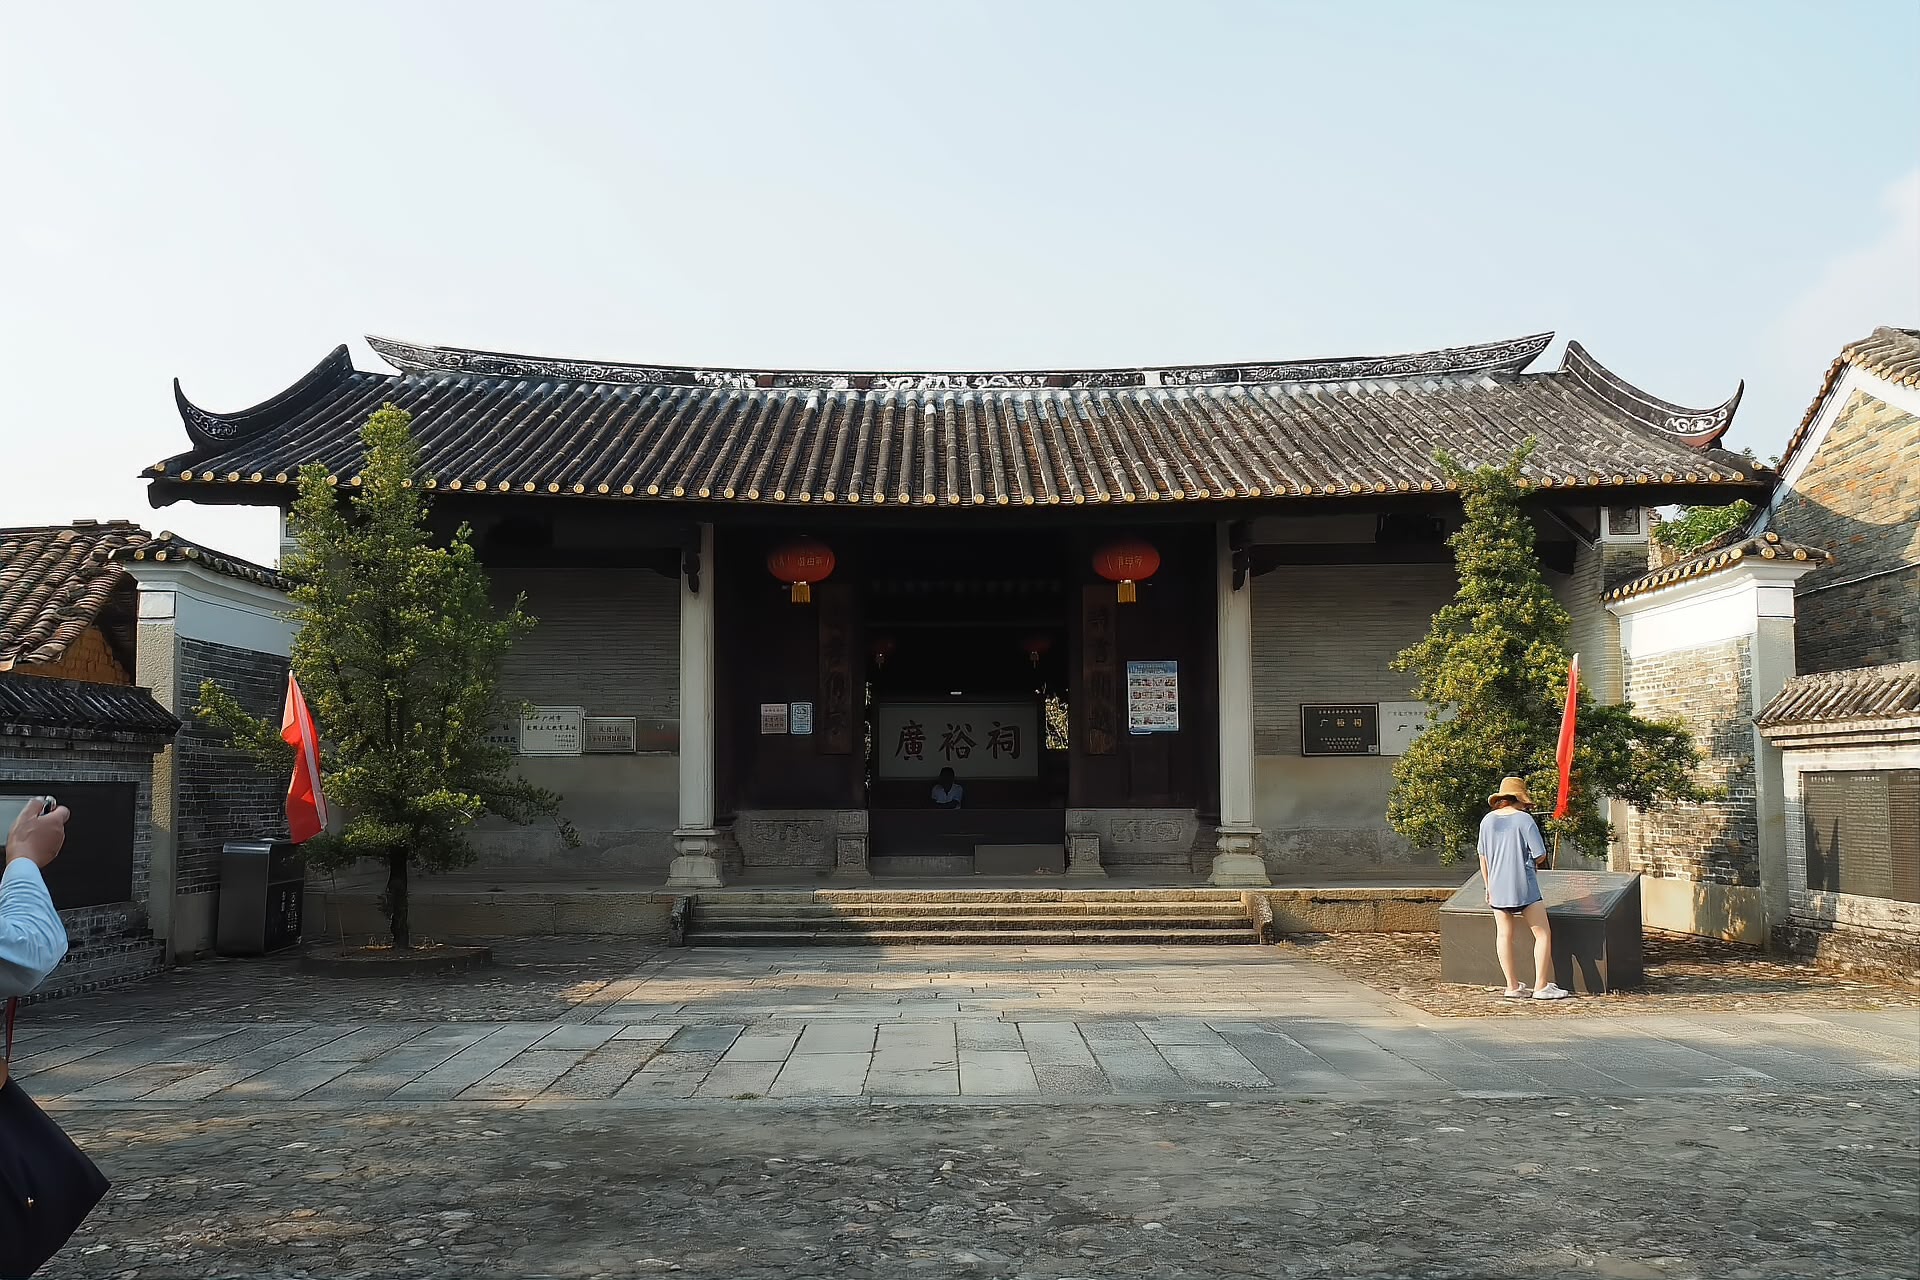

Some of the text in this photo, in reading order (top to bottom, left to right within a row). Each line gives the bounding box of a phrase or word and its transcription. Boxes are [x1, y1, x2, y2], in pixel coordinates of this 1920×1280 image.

[1319, 718, 1362, 727] 广裕祠
[894, 719, 1022, 761] 廣裕祠
